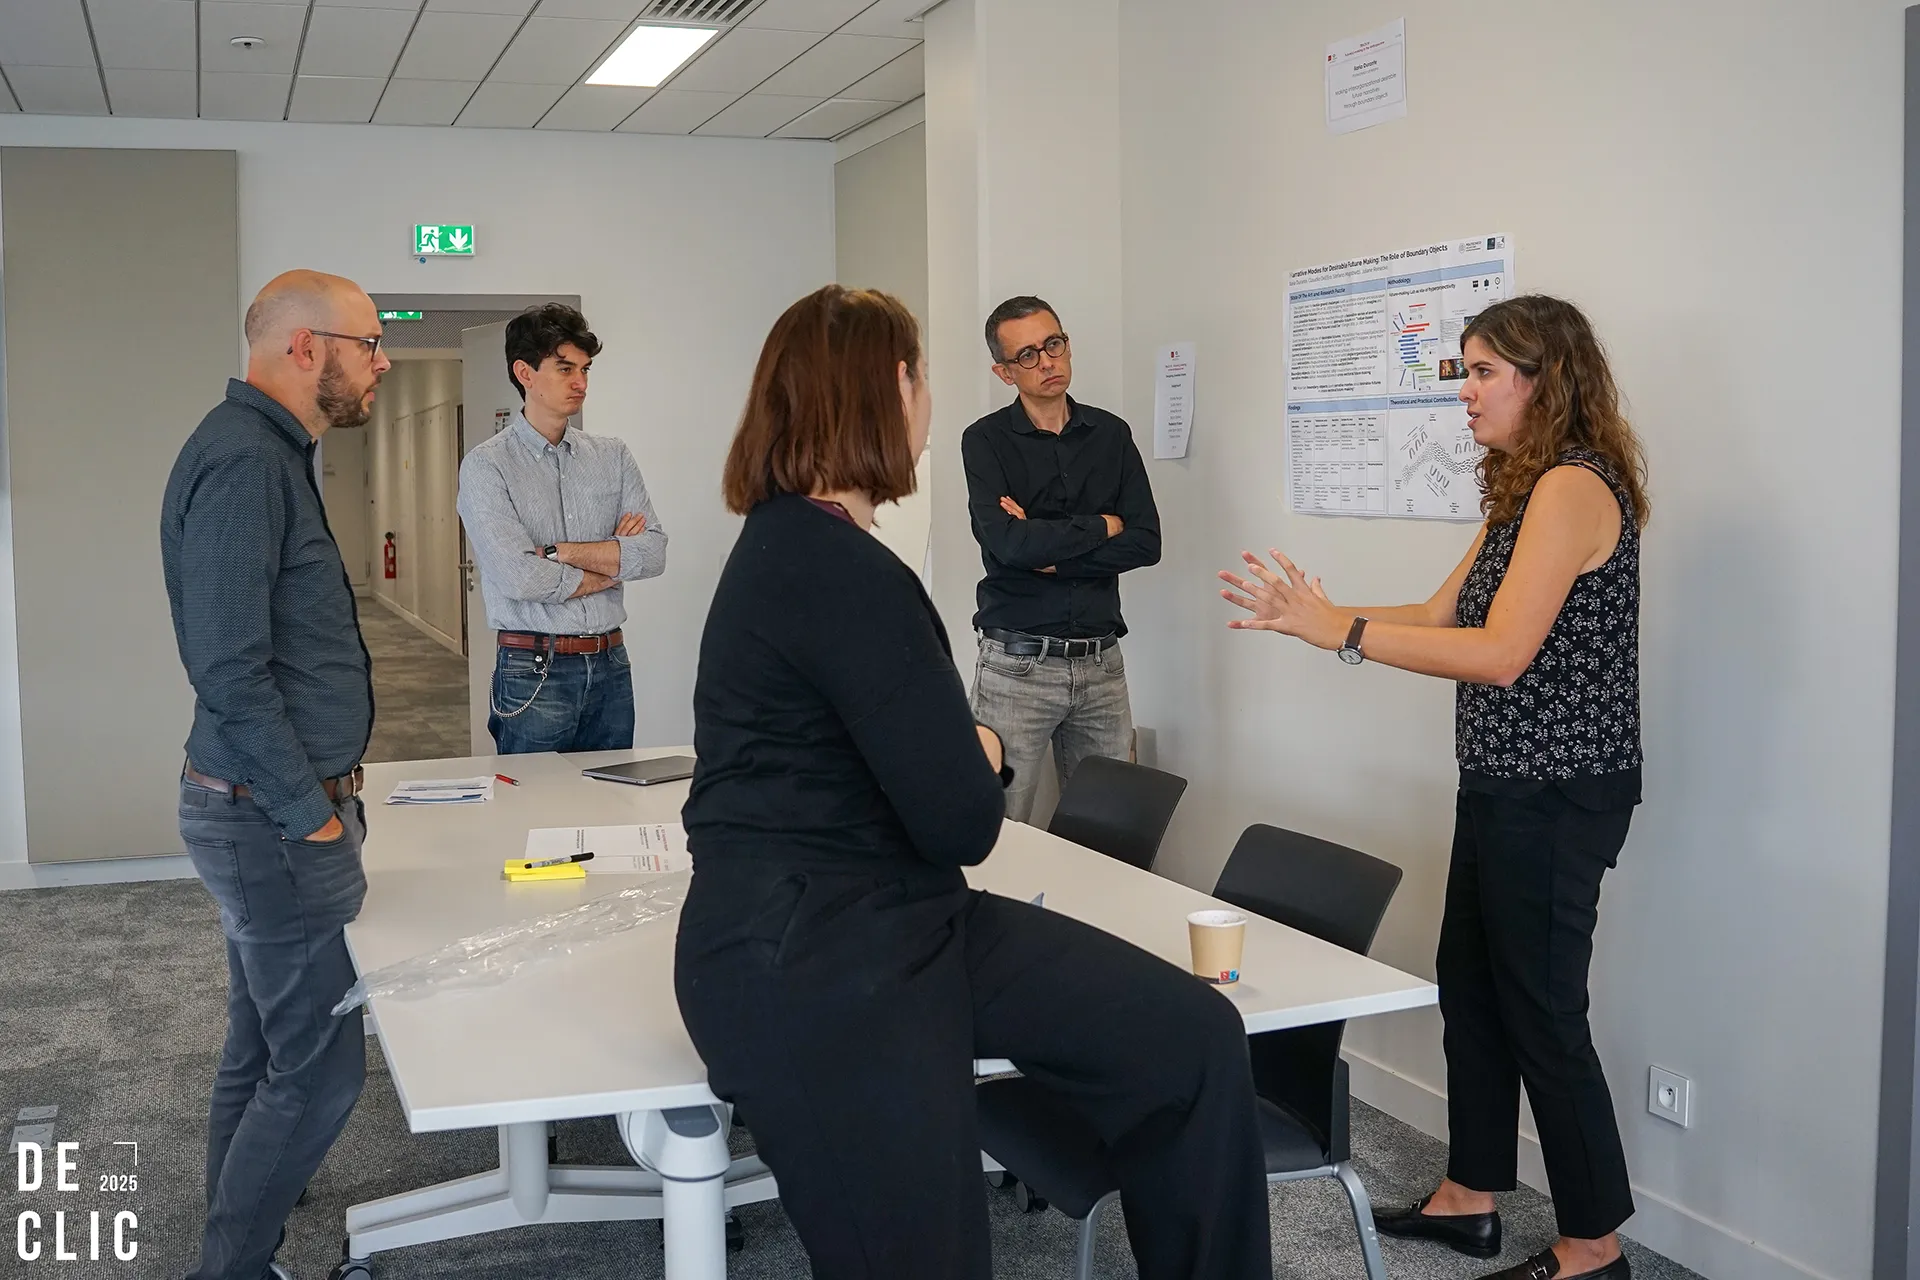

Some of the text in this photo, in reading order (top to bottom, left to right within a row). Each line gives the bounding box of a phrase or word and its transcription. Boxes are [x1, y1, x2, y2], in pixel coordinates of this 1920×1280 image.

[1362, 257, 1380, 265] Making:
[1388, 252, 1400, 260] Role
[1406, 246, 1428, 258] Boundary
[1429, 244, 1448, 254] Objects
